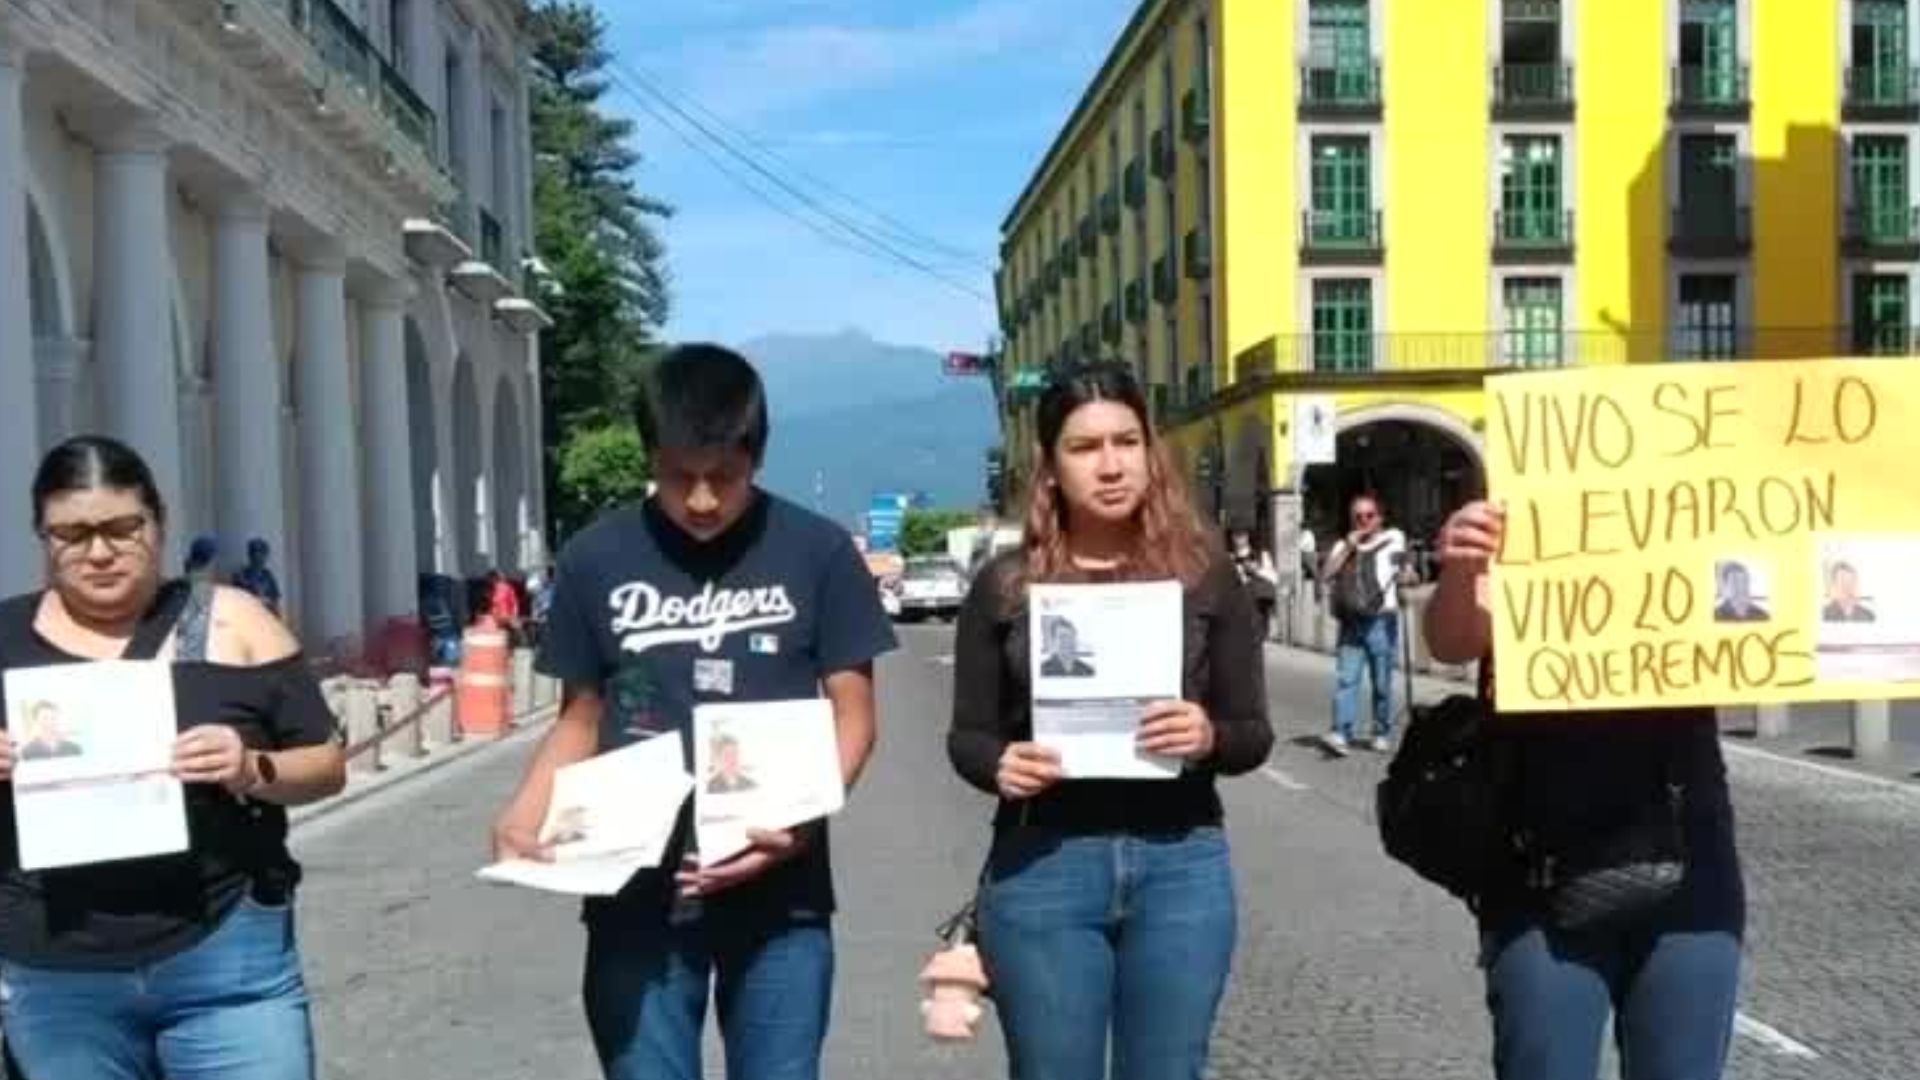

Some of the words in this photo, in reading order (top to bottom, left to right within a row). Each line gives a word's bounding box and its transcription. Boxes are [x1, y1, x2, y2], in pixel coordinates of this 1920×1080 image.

[1496, 391, 1634, 474] VIVO
[1653, 382, 1742, 457] SE
[1784, 376, 1877, 445] LO
[1495, 471, 1836, 566] LLEVARON
[609, 580, 796, 653] Dodgers
[1503, 574, 1614, 642] VIVO
[1633, 566, 1694, 631] LO
[1526, 629, 1815, 704] QUEREMOS
